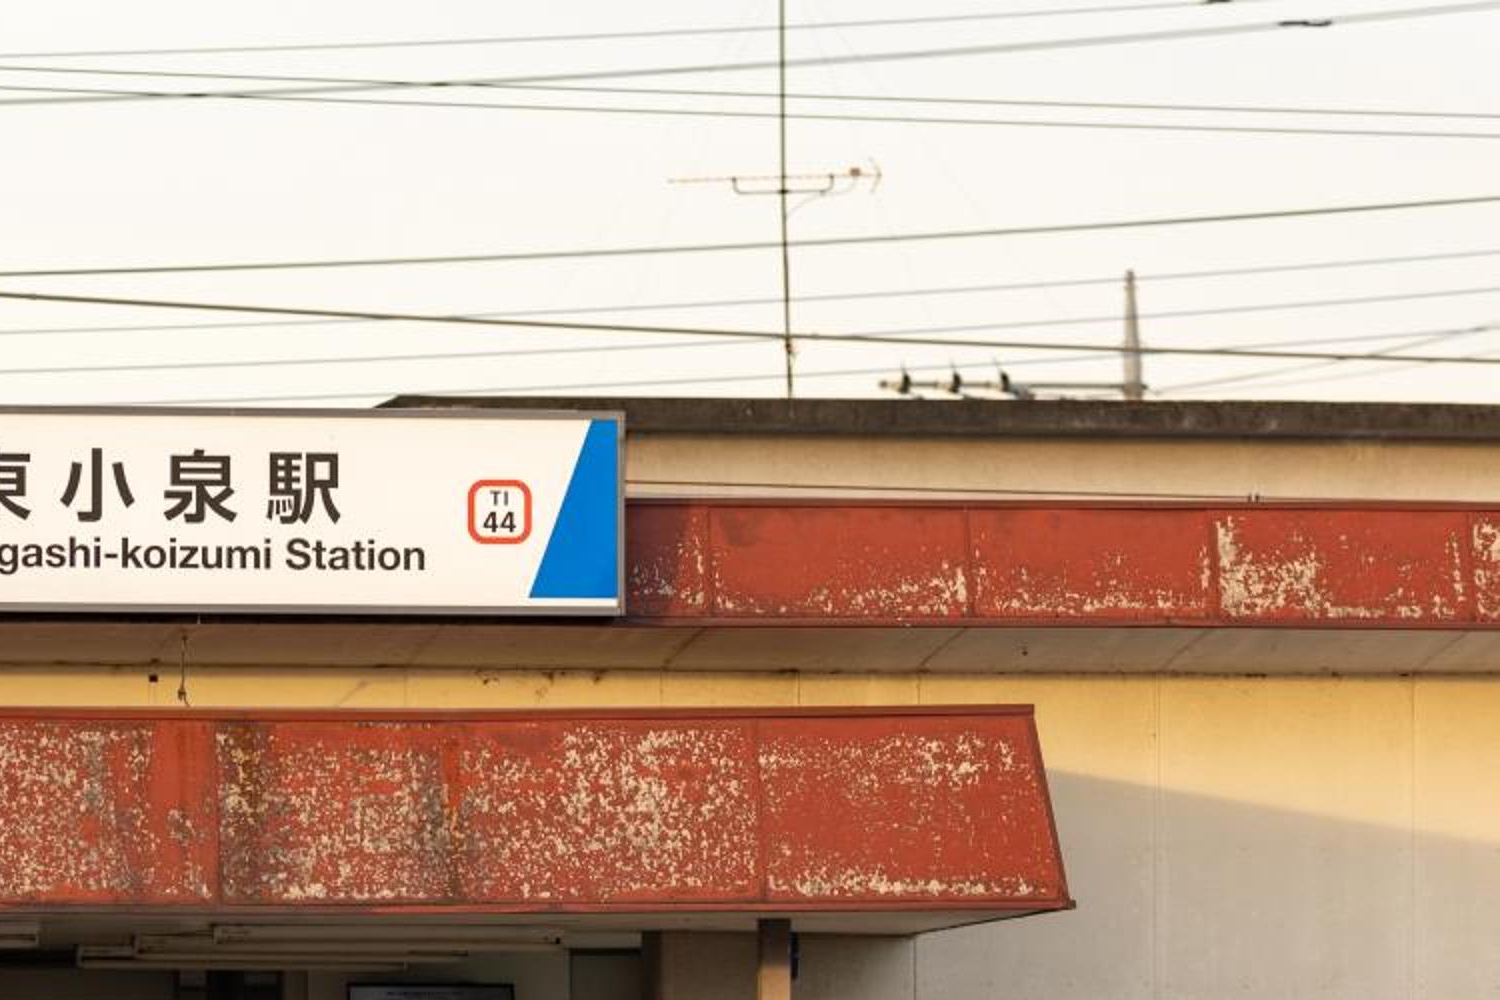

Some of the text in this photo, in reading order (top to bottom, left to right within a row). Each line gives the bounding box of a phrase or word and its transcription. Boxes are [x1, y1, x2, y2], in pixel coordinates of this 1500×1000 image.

[489, 490, 509, 506] TI
[483, 511, 517, 533] 44
[285, 537, 426, 572] Station
